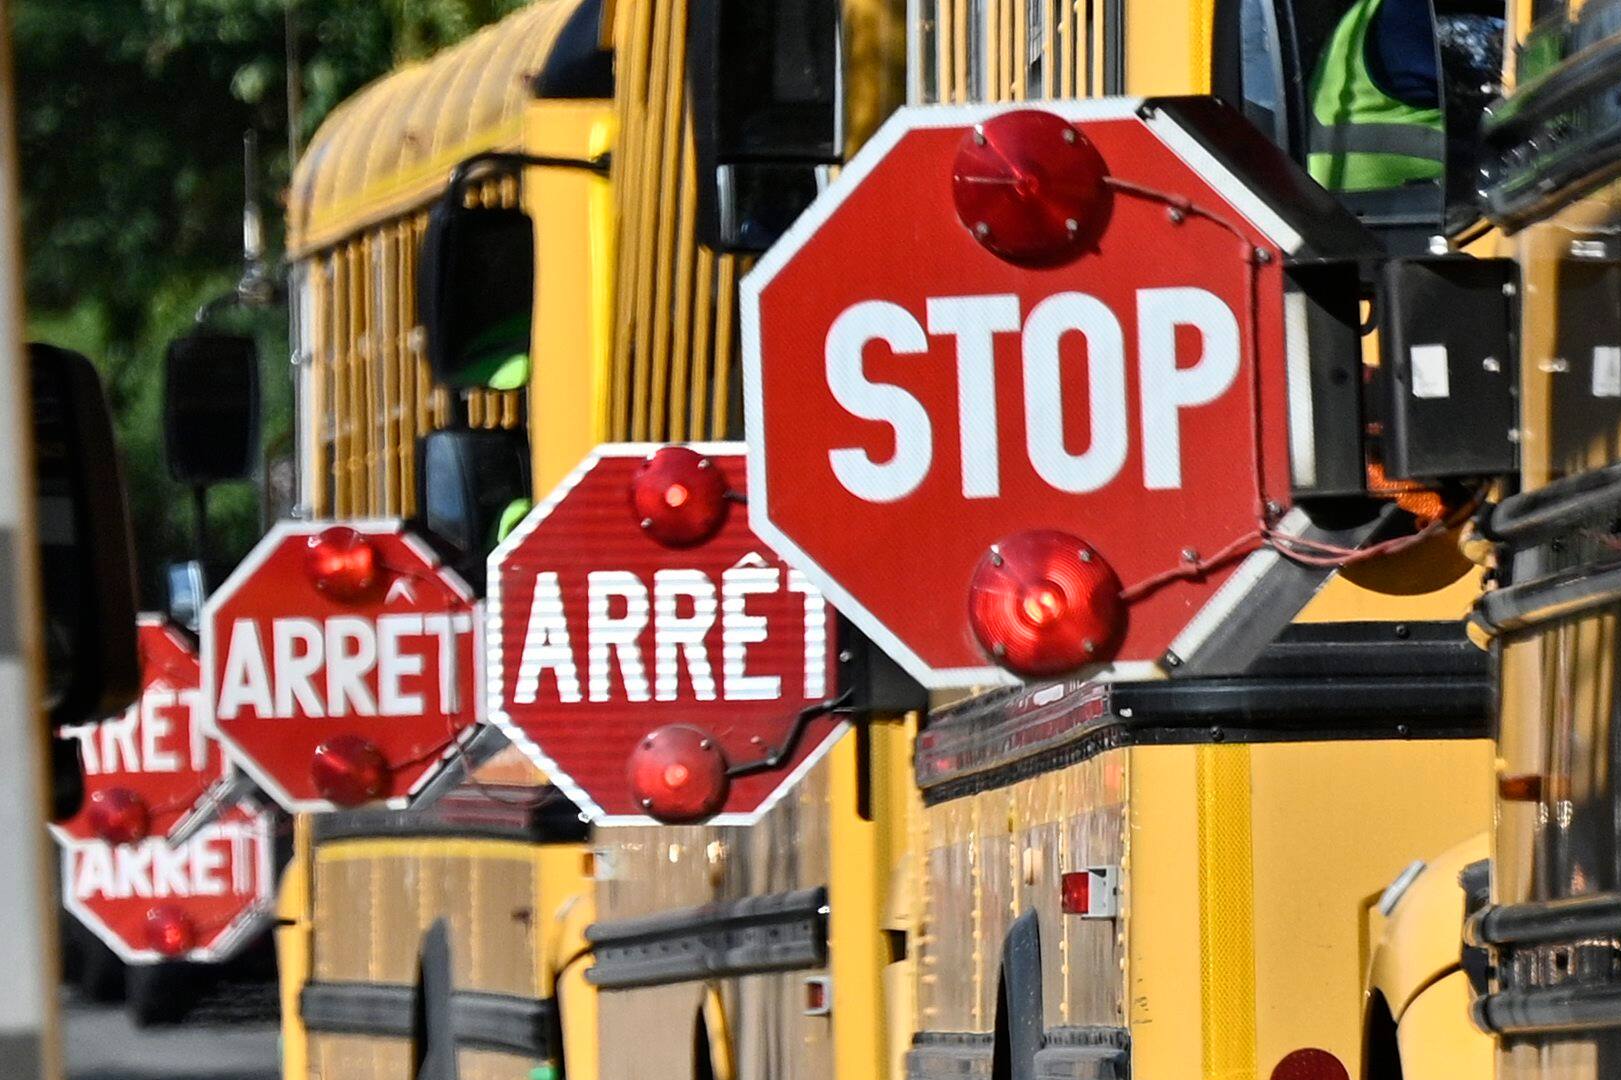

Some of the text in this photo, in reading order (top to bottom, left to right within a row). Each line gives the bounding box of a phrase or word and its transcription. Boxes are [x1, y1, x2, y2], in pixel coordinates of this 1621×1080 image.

[825, 287, 1241, 503] STOP
[217, 577, 473, 720] ARRÊT
[513, 551, 826, 704] ARRÊT
